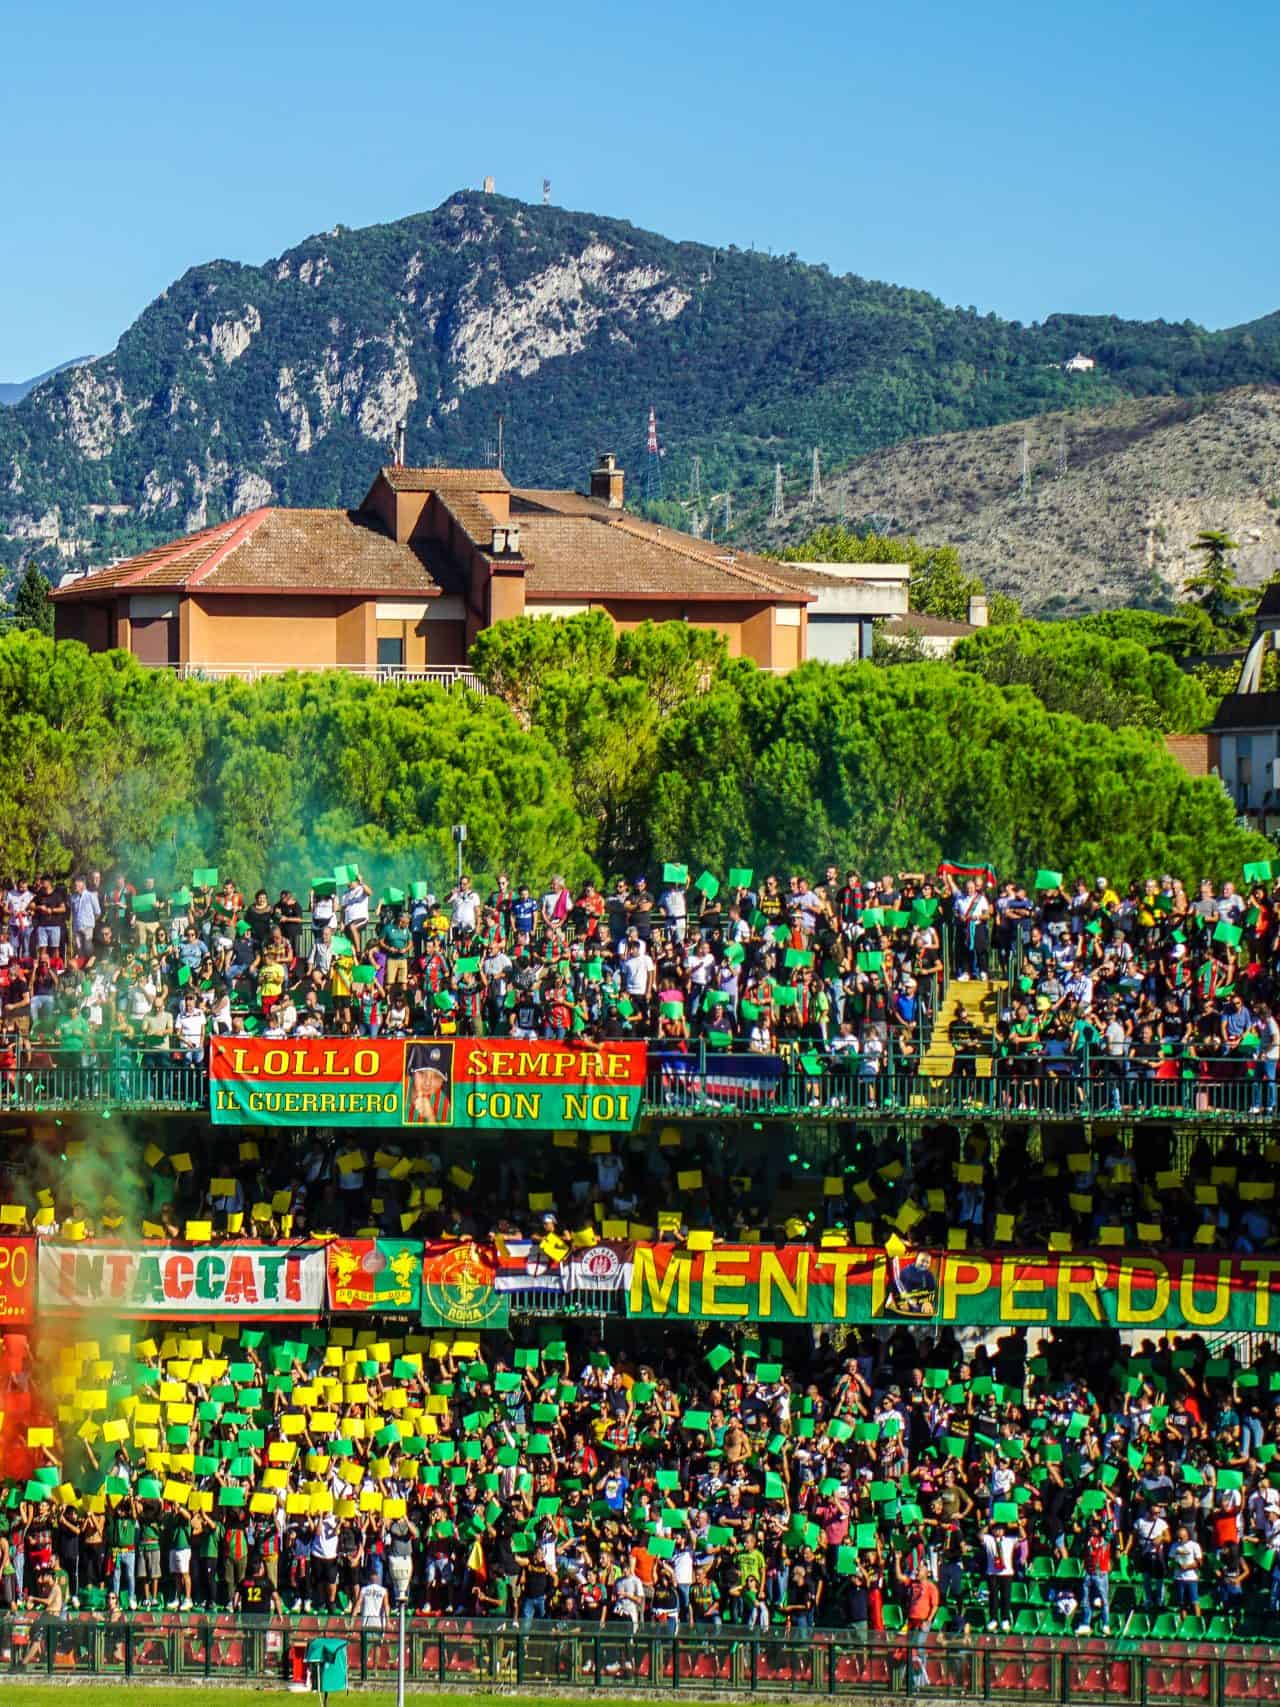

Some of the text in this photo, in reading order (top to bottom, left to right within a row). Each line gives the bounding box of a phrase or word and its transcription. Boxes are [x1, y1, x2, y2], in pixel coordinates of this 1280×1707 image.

[232, 1048, 380, 1076] LOLLO
[468, 1050, 631, 1078] SEMPRE
[215, 1090, 398, 1114] IL GUERRIERO
[466, 1092, 630, 1121] CON NOI
[59, 1253, 303, 1305] INTACCATI
[630, 1247, 887, 1319] MENTI
[447, 1307, 483, 1321] ROMA
[247, 1587, 261, 1602] 12
